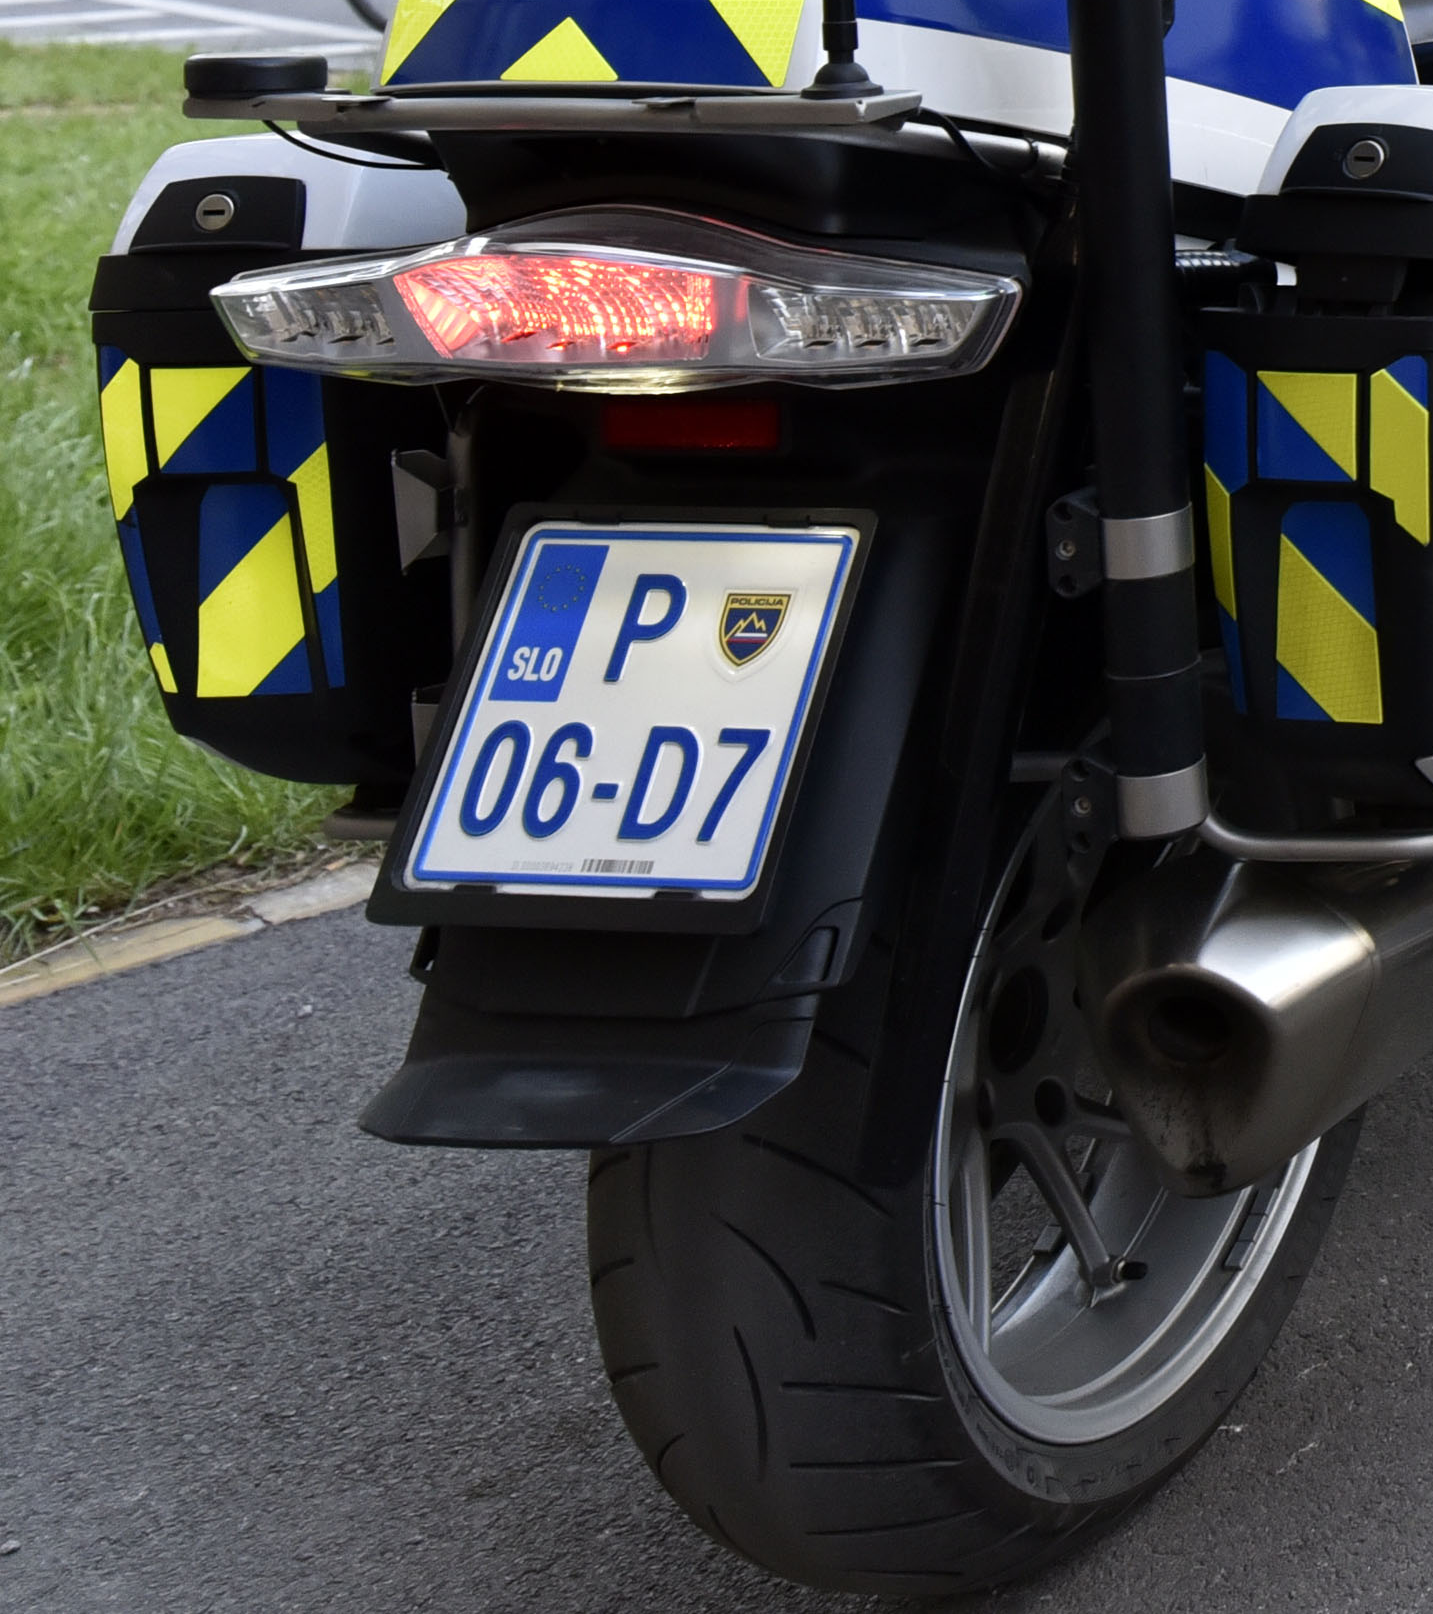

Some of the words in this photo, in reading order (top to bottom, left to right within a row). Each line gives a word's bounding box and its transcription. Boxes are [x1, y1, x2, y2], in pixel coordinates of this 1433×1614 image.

[603, 573, 688, 683] P
[730, 597, 784, 606] POLICIJA
[507, 646, 563, 682] SLO
[459, 719, 772, 844] 06-D7
